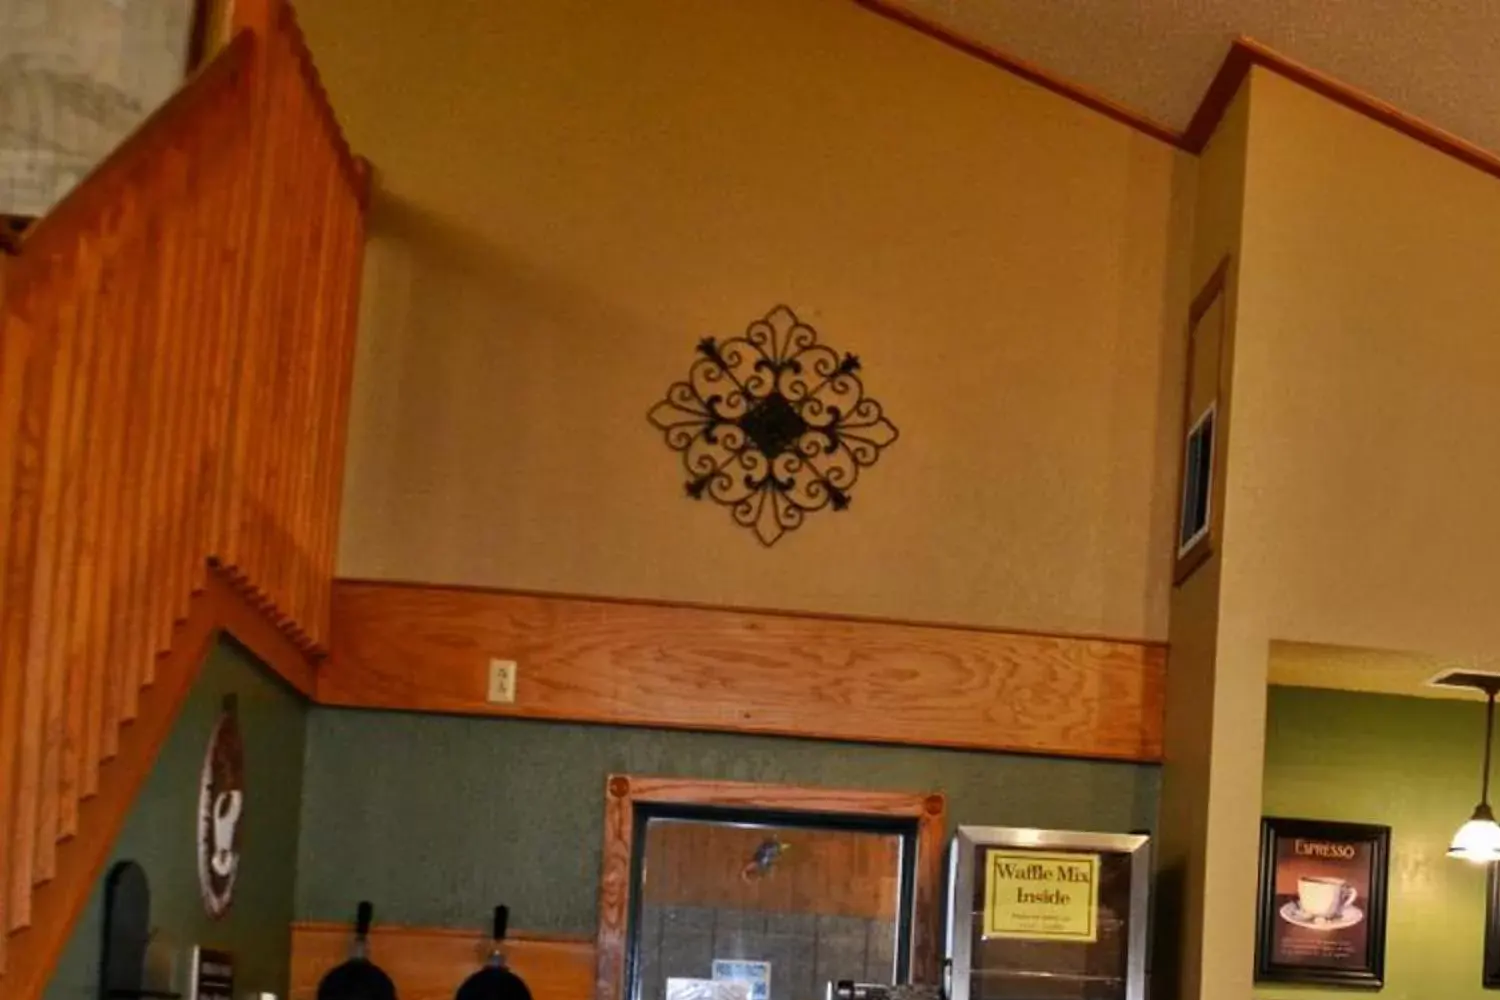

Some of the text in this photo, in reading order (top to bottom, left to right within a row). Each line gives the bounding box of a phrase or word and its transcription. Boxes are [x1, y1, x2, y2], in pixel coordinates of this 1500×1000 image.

[996, 862, 1090, 883] Waffle Mix
[1016, 886, 1071, 905] Inside
